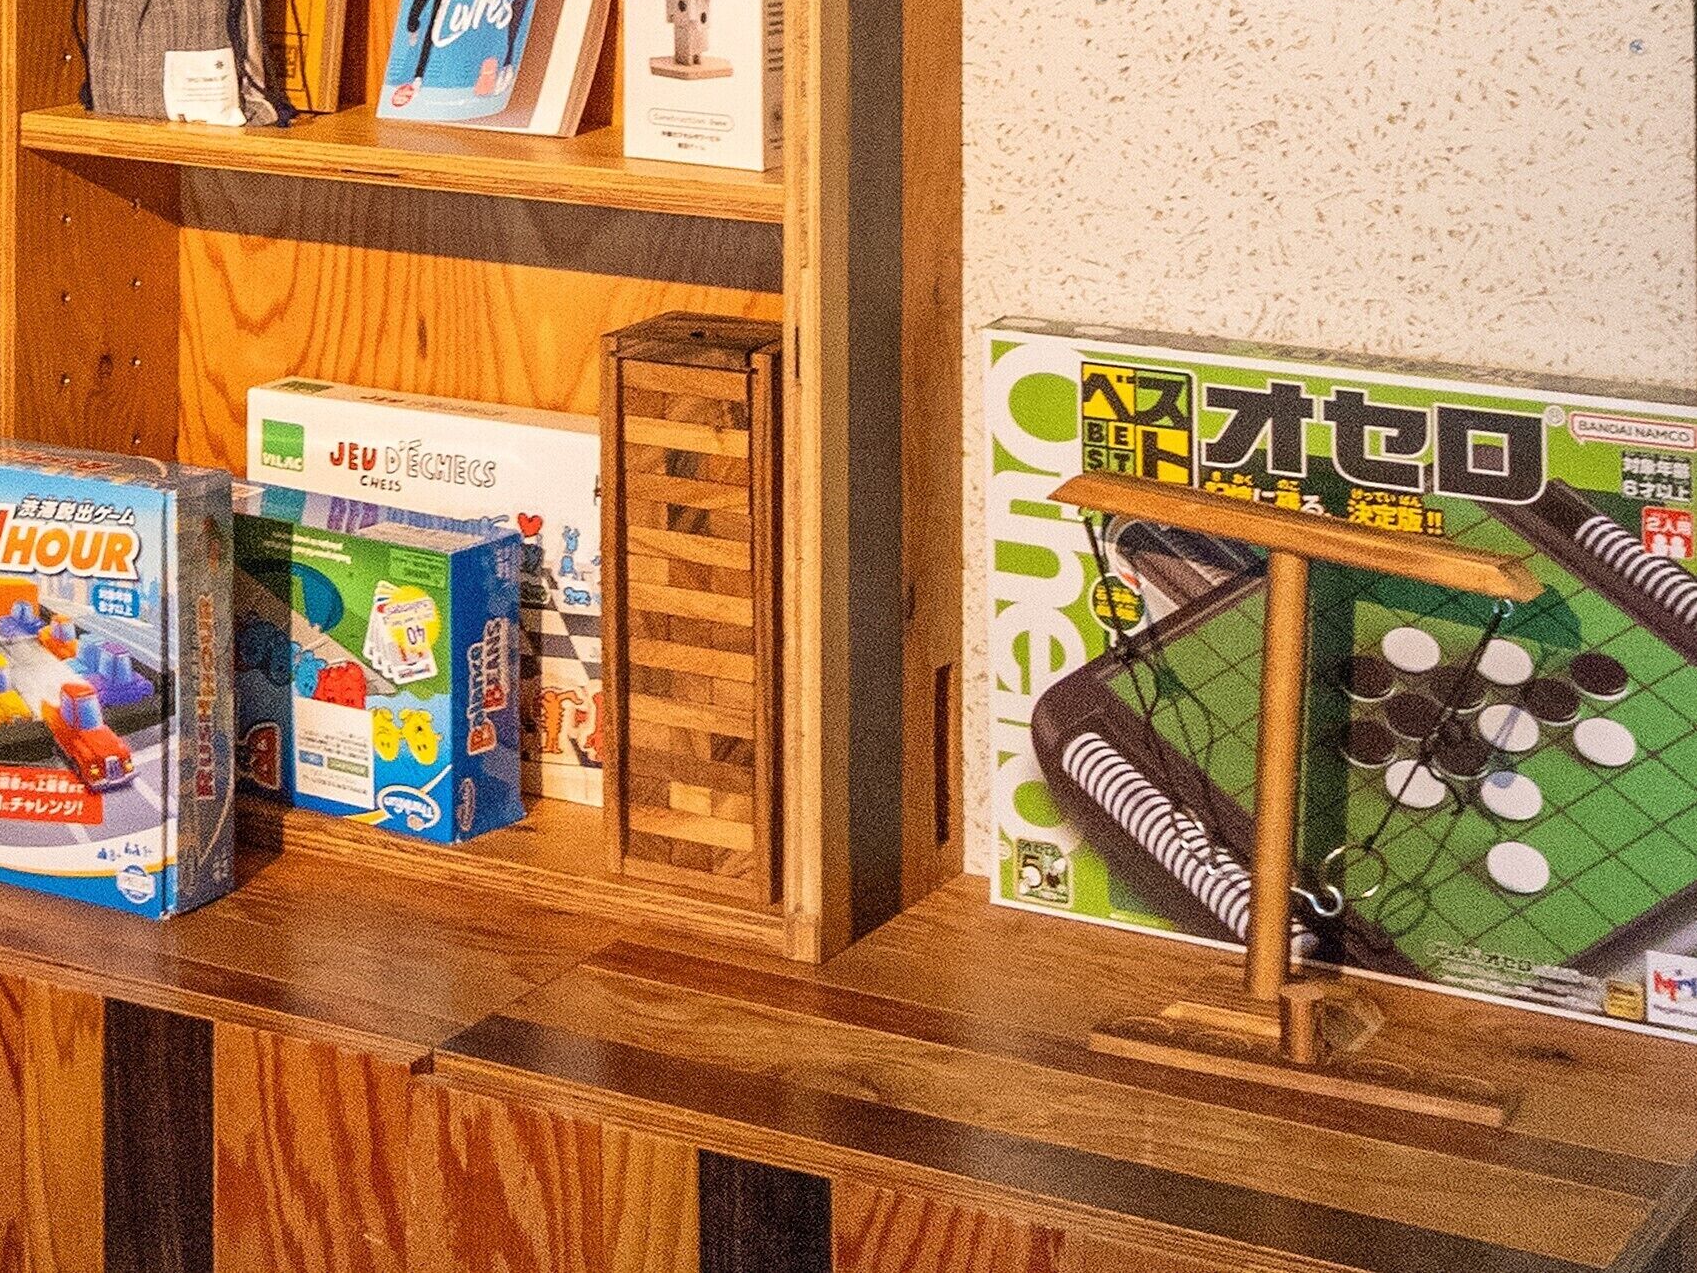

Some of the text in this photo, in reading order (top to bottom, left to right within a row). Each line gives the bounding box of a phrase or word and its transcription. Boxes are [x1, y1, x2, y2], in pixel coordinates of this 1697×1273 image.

[1203, 382, 1547, 502] オセロ
[1578, 420, 1690, 442] BANDAI NAMCO
[263, 453, 302, 471] VILAC
[329, 439, 496, 488] JEU D'ÉCHECS
[360, 475, 402, 492] CHESS
[1347, 499, 1443, 535] 決定版!!
[2, 525, 138, 573] HOUR
[483, 619, 506, 709] BEANS
